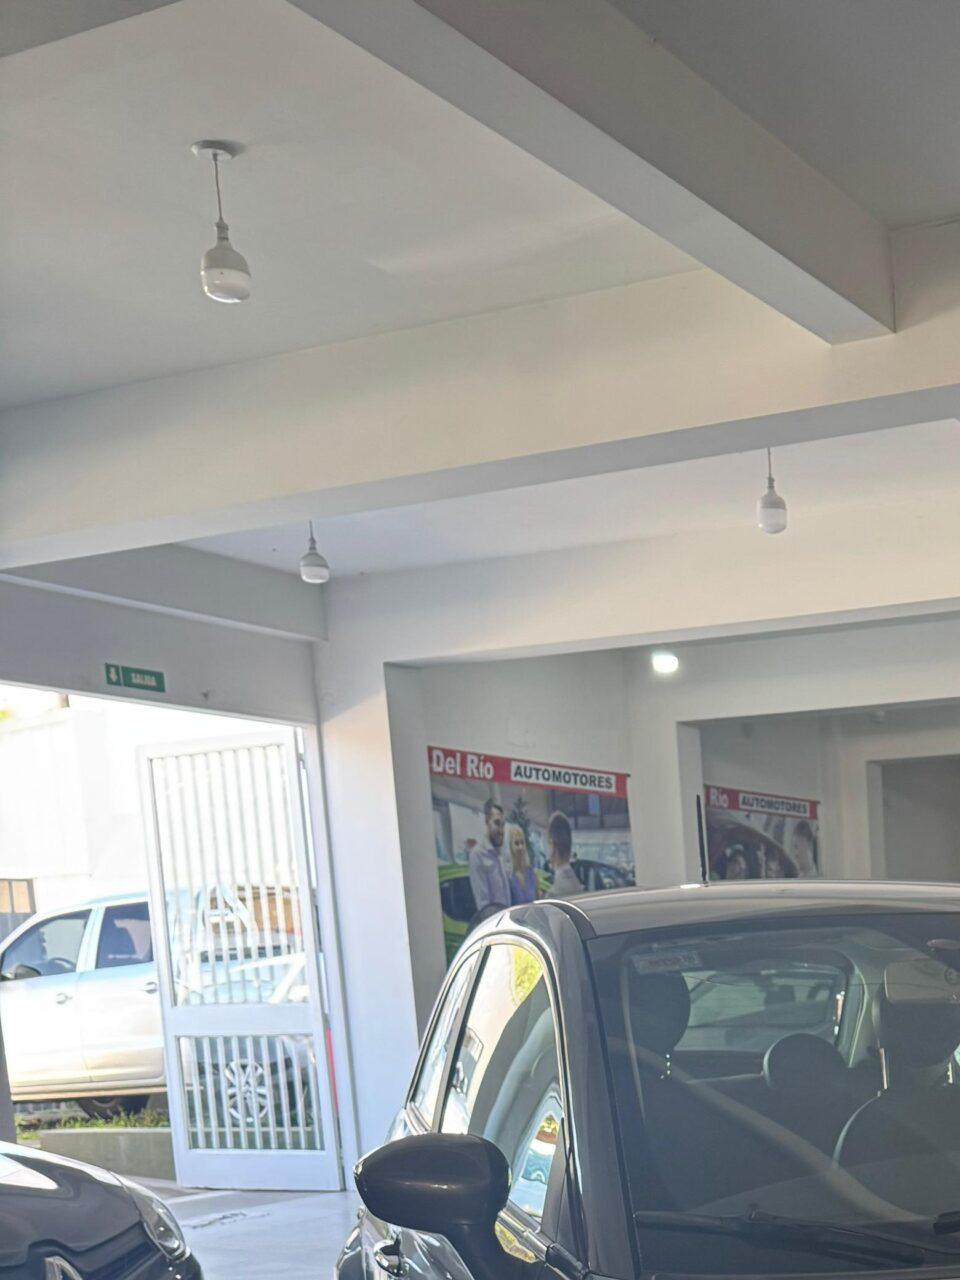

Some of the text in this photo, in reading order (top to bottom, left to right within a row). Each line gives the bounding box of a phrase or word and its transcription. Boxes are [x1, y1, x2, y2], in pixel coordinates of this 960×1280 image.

[432, 749, 613, 790] Del Río AUTOMOTORES
[741, 795, 807, 814] AUTOMOTORES
